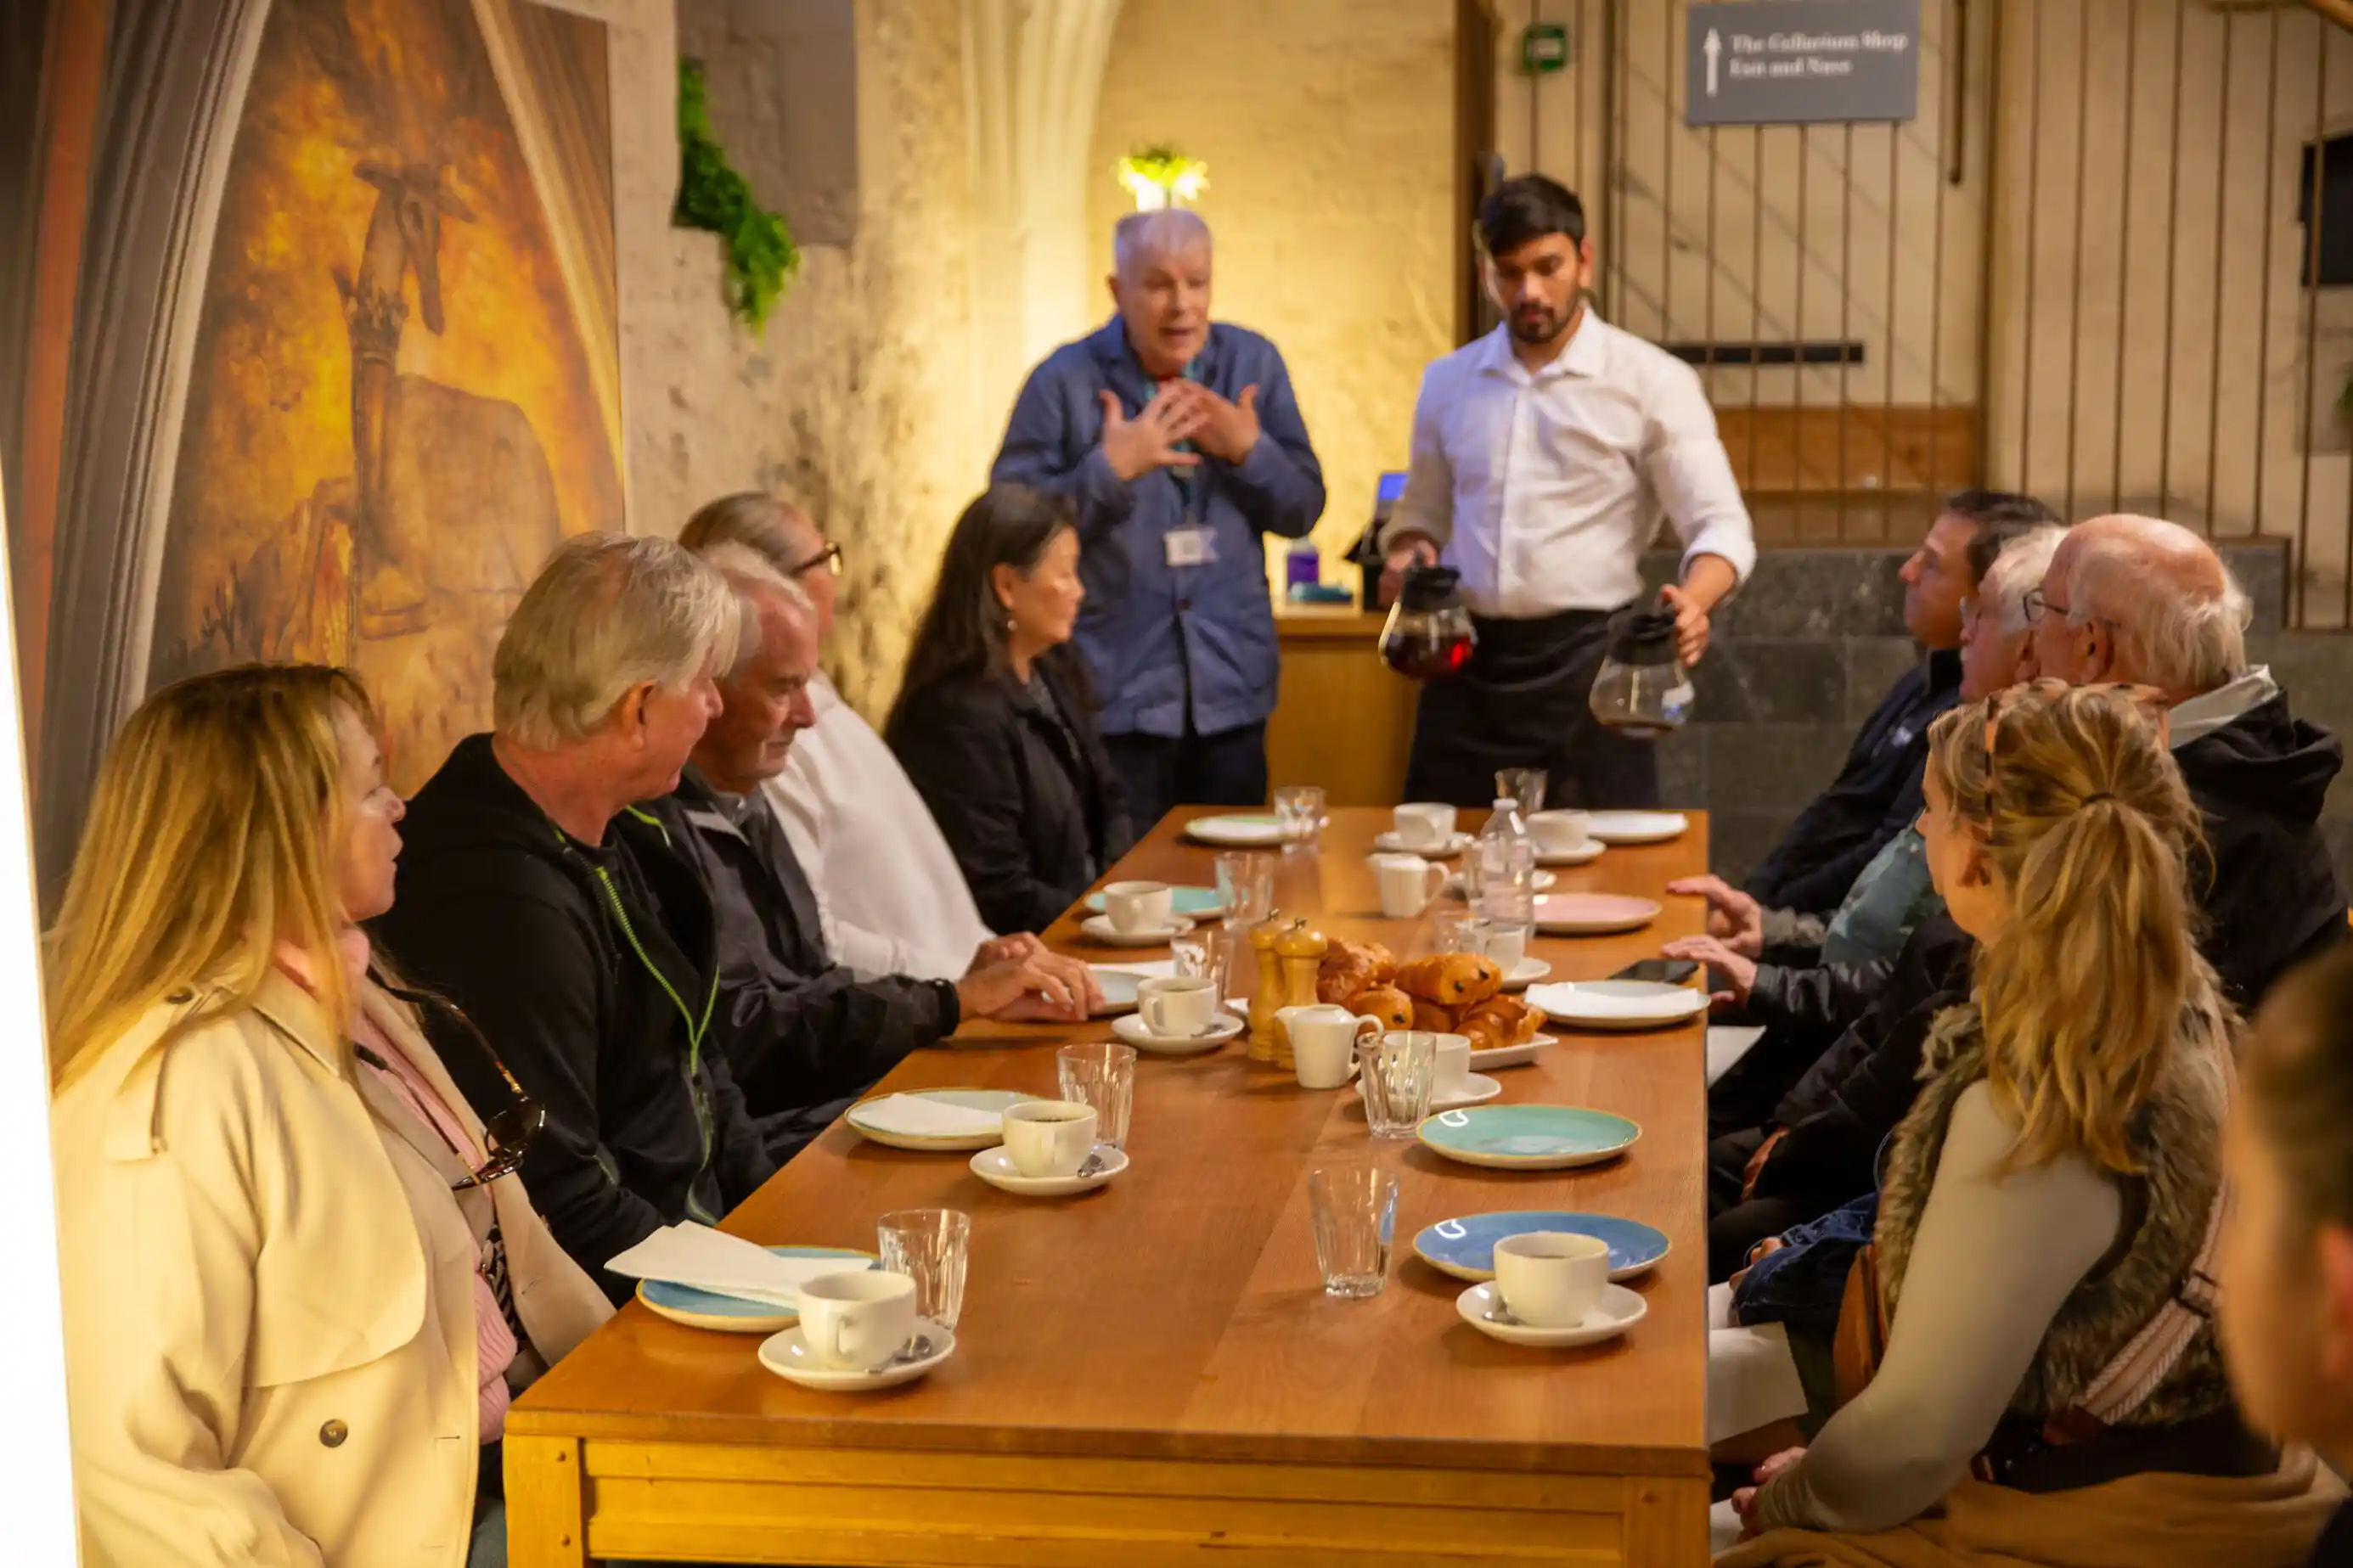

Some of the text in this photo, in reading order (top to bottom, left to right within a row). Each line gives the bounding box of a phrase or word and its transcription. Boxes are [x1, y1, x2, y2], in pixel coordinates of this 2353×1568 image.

[1731, 34, 1764, 53] The
[1861, 29, 1908, 53] Shop
[1769, 56, 1804, 76] and
